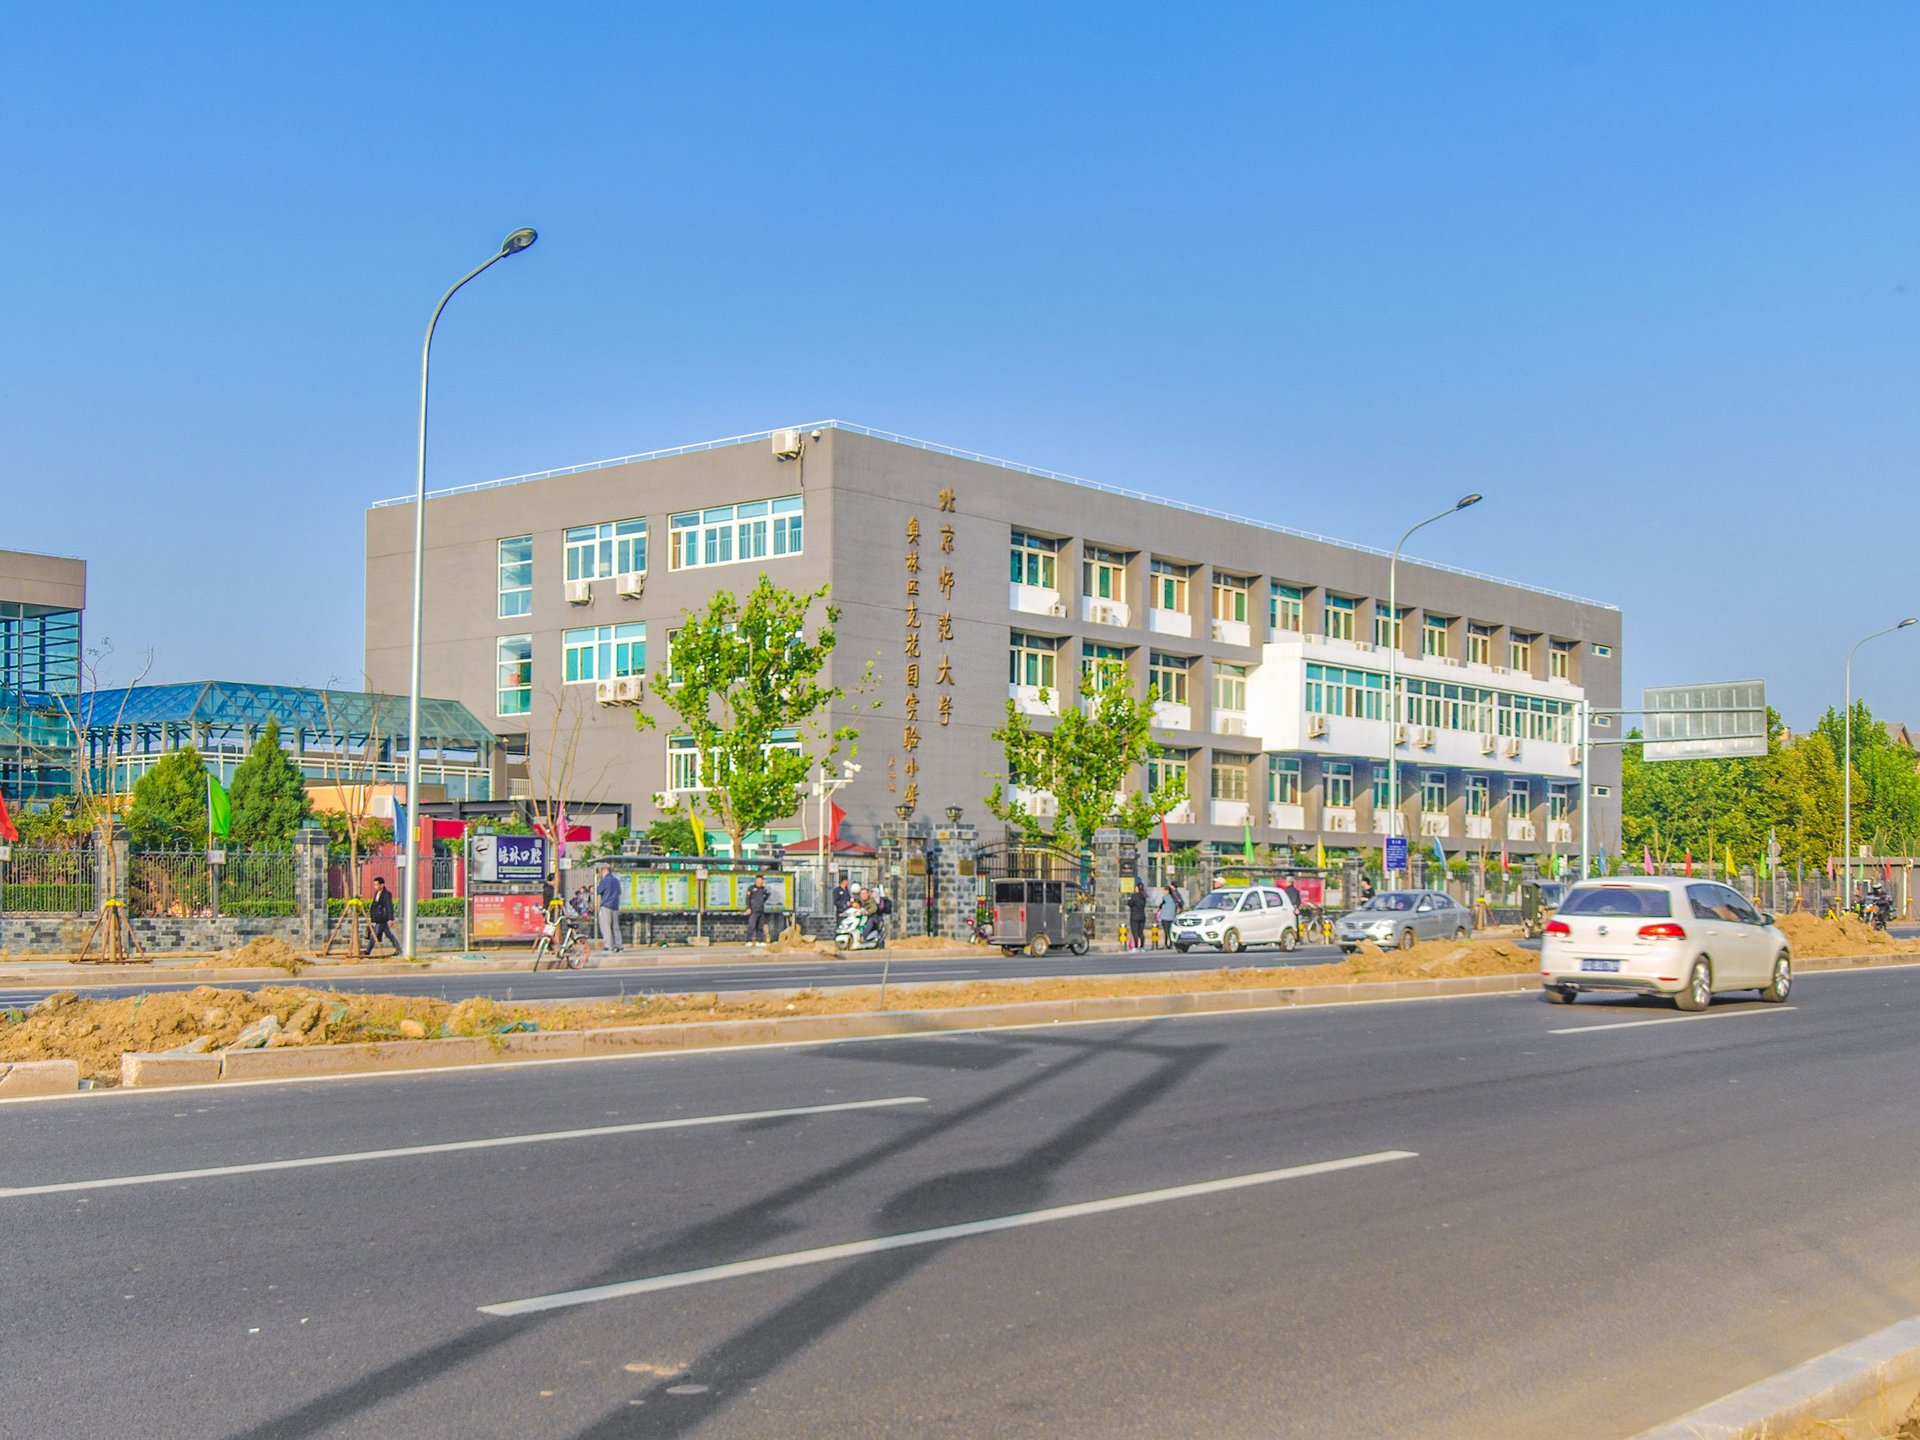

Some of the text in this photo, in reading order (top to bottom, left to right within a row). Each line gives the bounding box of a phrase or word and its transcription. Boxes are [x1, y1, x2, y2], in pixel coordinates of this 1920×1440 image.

[936, 485, 956, 726] 北京师范大学
